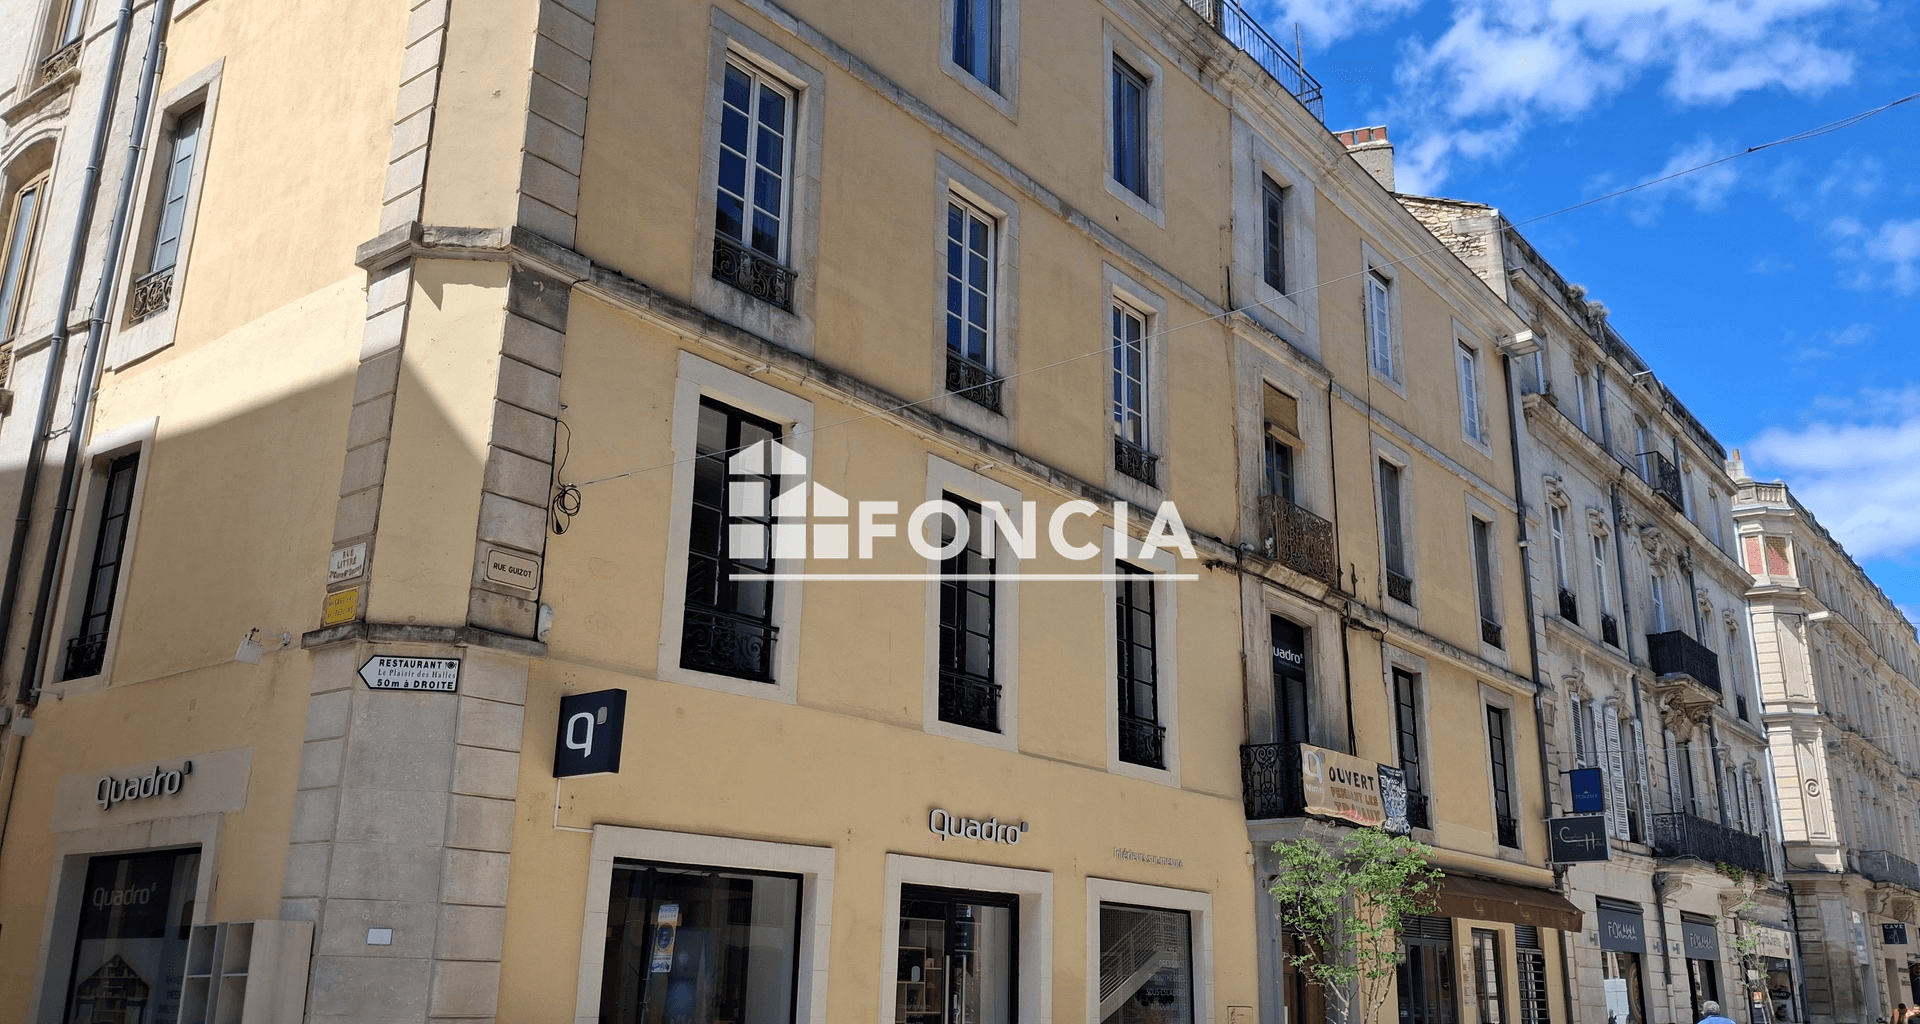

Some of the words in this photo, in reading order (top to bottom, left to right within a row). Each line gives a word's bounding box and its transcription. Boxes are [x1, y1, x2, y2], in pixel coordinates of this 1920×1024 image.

[342, 548, 355, 559] RUE
[493, 562, 507, 572] RUE
[508, 566, 532, 578] GUIZOT
[379, 659, 443, 669] RESTAURANT
[1272, 646, 1302, 665] uadro
[389, 669, 415, 677] Plaisir
[417, 670, 429, 678] des
[432, 671, 456, 679] Halles
[403, 680, 409, 688] à
[413, 680, 454, 690] DROITE
[1328, 766, 1374, 791] OUVERT
[97, 766, 182, 811] Quadro
[929, 808, 1022, 845] Quadro
[93, 884, 150, 911] Quadro
